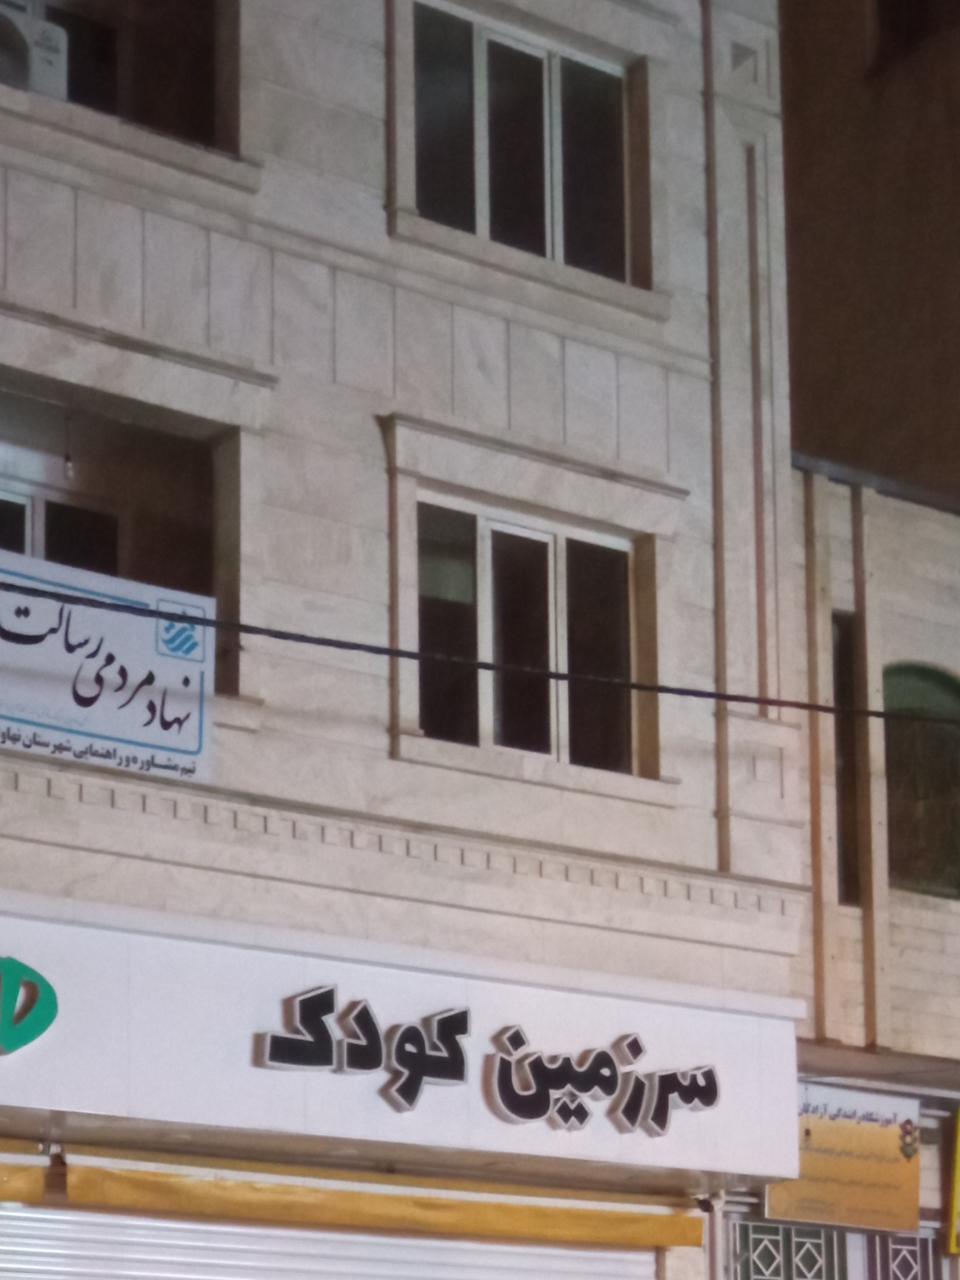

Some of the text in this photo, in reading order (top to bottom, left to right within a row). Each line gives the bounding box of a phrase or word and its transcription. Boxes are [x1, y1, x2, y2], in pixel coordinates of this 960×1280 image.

[72, 652, 156, 710] مردمی
[142, 675, 191, 734] نهاد
[241, 985, 721, 1138] سرزمین کودک
